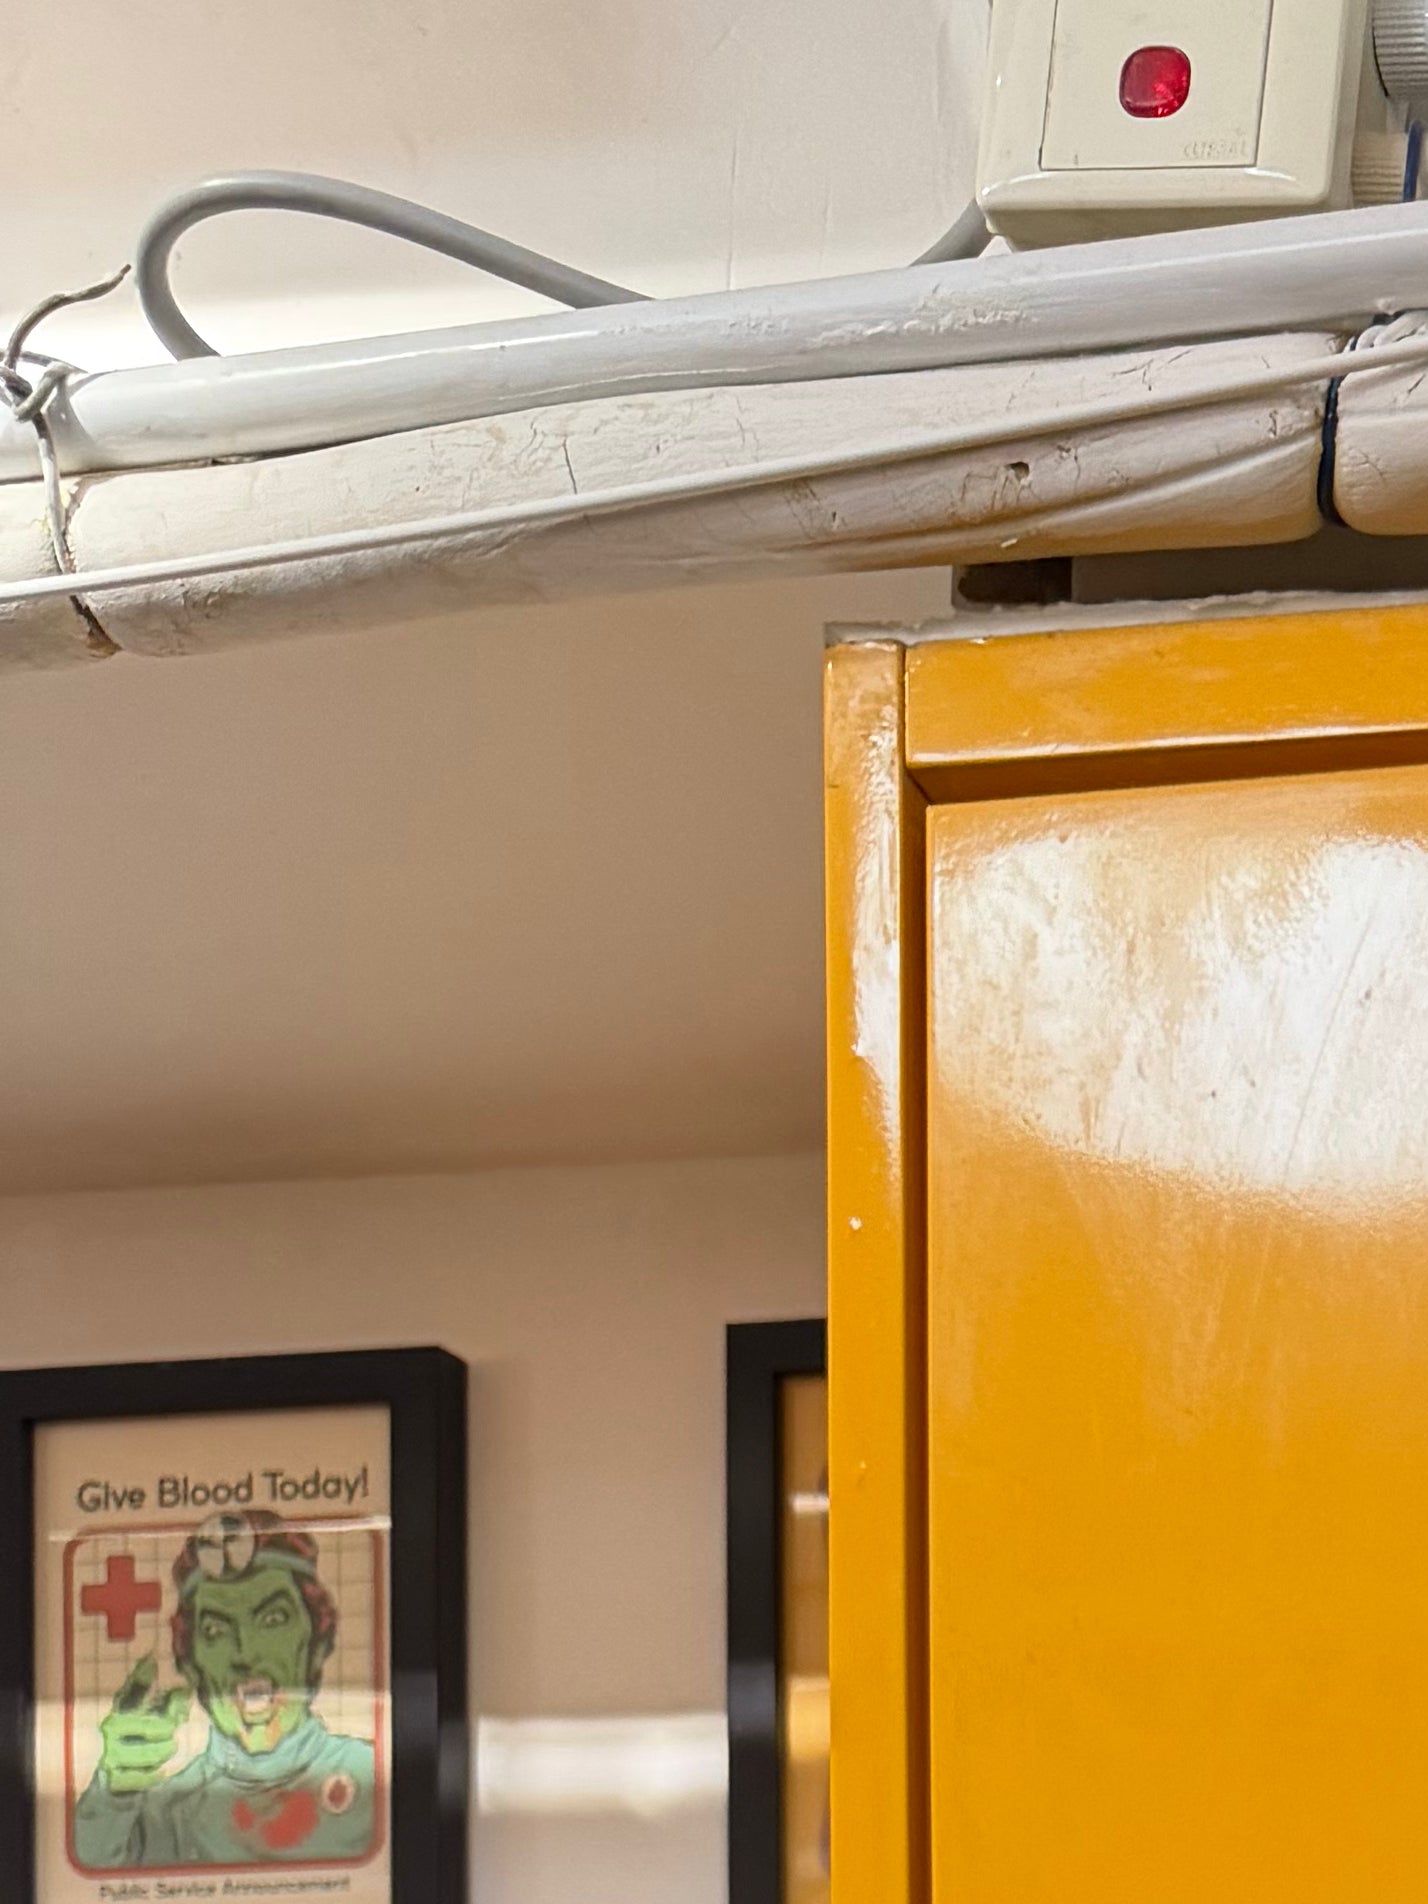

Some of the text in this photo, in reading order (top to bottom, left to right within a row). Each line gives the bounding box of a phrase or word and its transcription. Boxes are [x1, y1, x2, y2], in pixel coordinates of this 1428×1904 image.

[76, 1464, 369, 1513] Give Blood Today!
